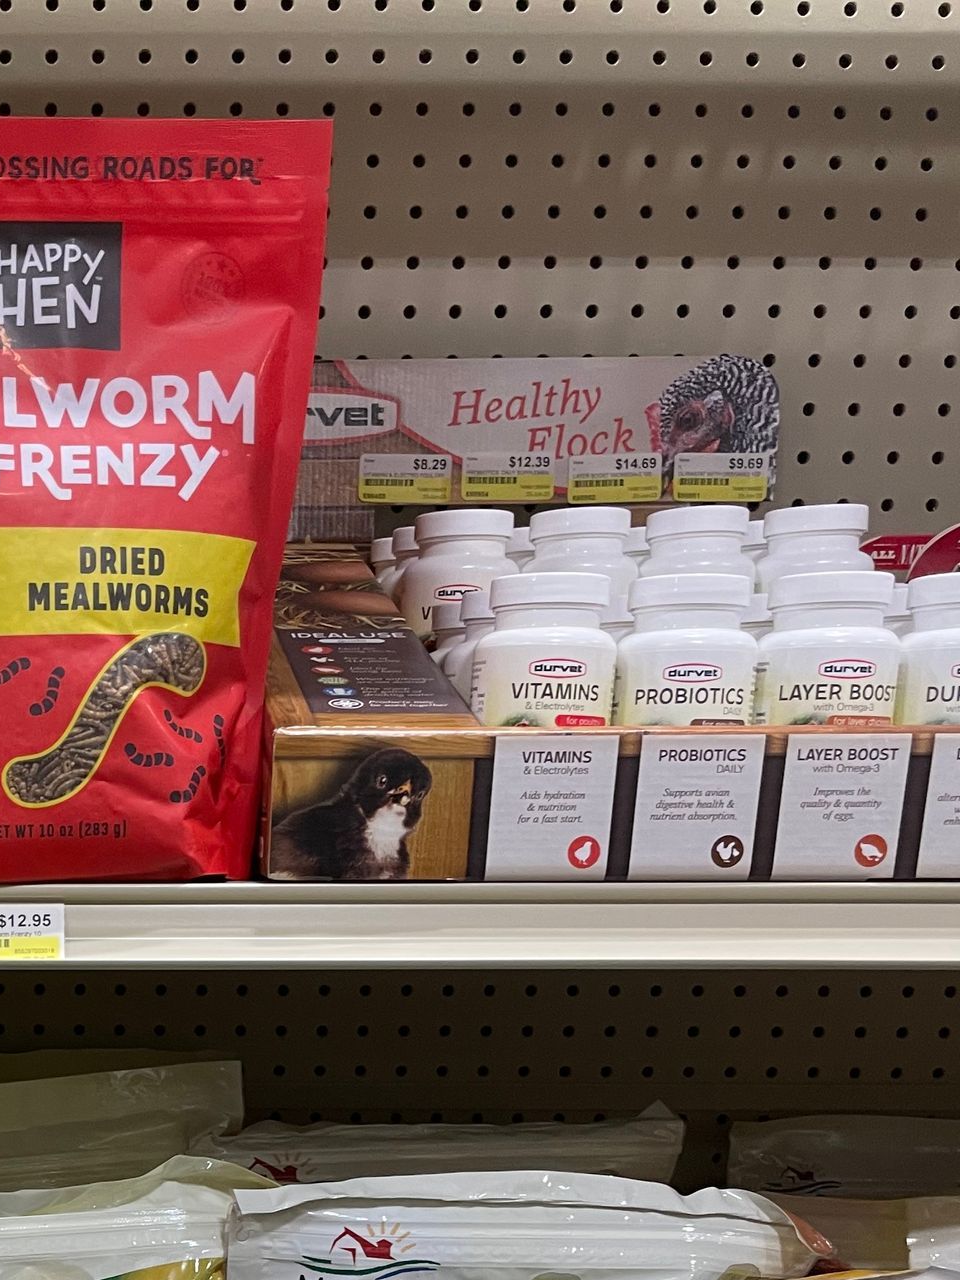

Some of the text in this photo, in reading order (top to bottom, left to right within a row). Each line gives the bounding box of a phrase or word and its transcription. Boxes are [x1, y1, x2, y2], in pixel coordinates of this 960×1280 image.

[102, 156, 193, 180] ROADS
[204, 157, 261, 185] FOR
[448, 378, 601, 424] Healthy
[527, 417, 635, 459] Flock
[413, 458, 447, 471] $8.29
[509, 456, 550, 469] $12.39
[615, 458, 657, 470] $14.69
[729, 458, 764, 470] $9.69
[79, 546, 166, 577] DRIED
[28, 583, 210, 618] MEALWORMS
[359, 631, 407, 639] USE
[533, 663, 583, 674] durvet
[668, 668, 718, 678] durvet
[823, 664, 874, 674] durvet
[511, 682, 600, 702] VITAMINS
[634, 687, 744, 706] PROBIOTICS
[778, 683, 897, 702] LAYER BOOST
[522, 750, 593, 764] VITAMINS
[658, 748, 747, 762] PROBIOTICS
[797, 748, 900, 761] LAYER BOOST
[534, 765, 589, 777] Electrolytes
[716, 764, 745, 774] DAILY
[812, 763, 880, 775] with Omega-3
[520, 790, 586, 802] Aids hydration
[662, 788, 730, 799] Supports avian
[813, 787, 871, 798] Improves the
[538, 803, 577, 812] nutrition
[655, 800, 725, 811] digestive health
[800, 800, 882, 811] quality quantity
[517, 814, 559, 825] for fast
[649, 812, 687, 821] nutrient
[15, 824, 34, 839] WT
